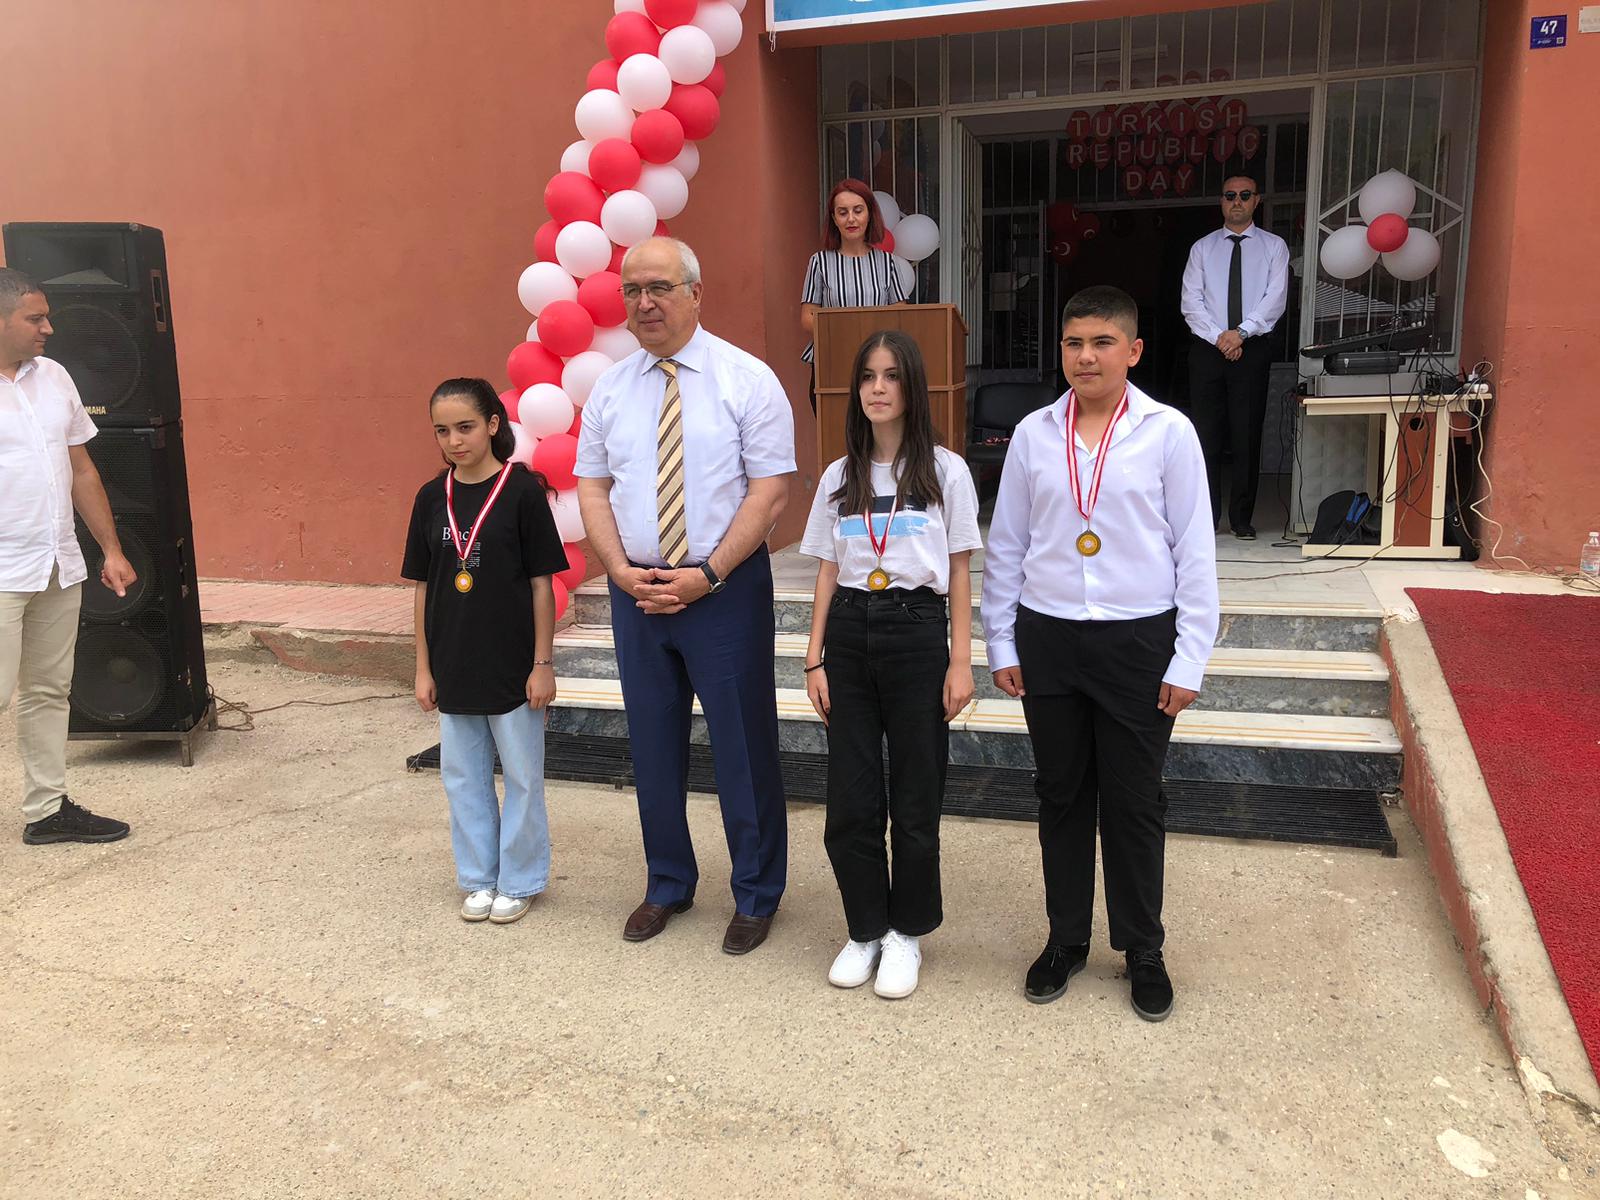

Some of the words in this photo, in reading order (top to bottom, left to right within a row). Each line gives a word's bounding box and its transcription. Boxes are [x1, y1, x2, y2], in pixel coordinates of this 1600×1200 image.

[1540, 20, 1558, 35] 47
[1071, 105, 1244, 137] TURKISH
[1069, 132, 1259, 164] REPUBLIC
[1126, 168, 1192, 190] DAY
